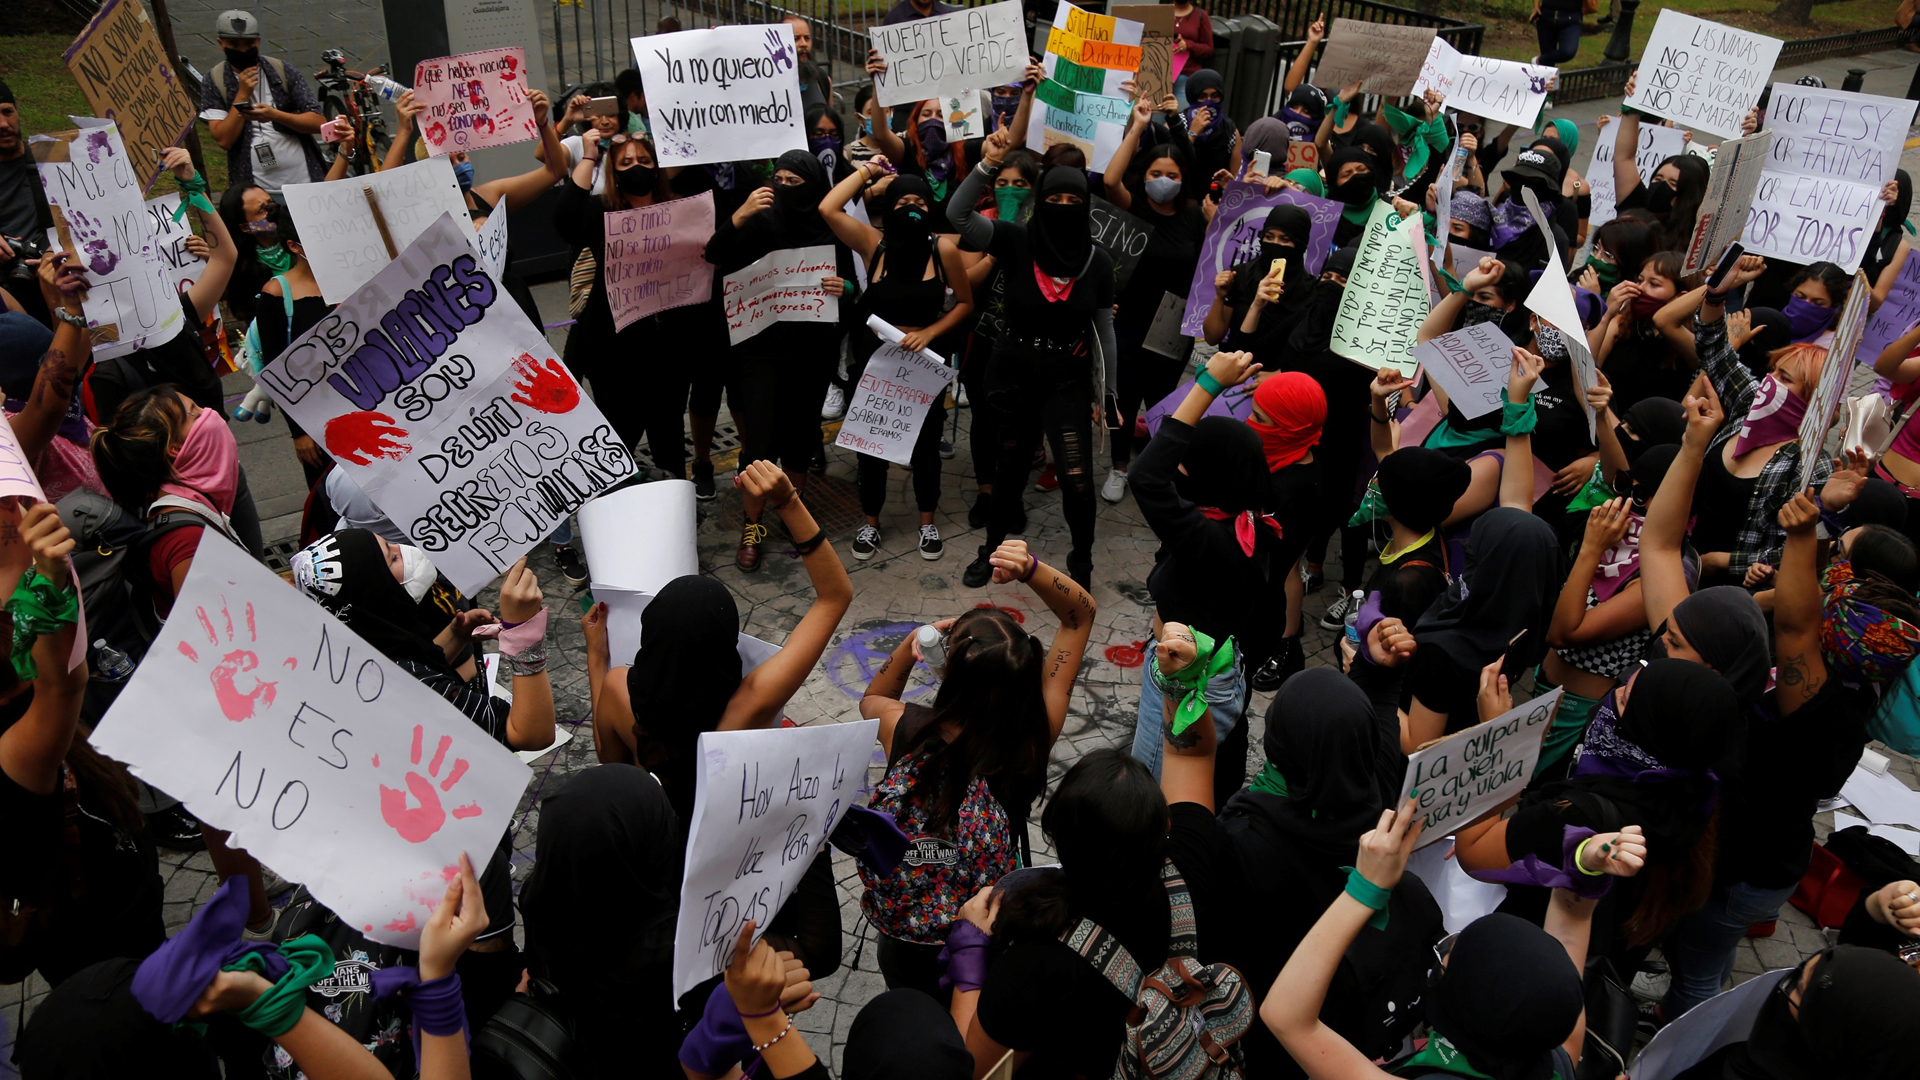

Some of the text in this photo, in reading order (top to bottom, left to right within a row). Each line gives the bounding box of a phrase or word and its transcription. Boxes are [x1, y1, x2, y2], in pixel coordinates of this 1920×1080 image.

[472, 4, 510, 14] Guadalajara
[1085, 13, 1109, 43] Hija
[79, 1, 143, 98] NO SOMOS
[871, 10, 1006, 54] MUERTE AL
[1691, 25, 1762, 66] LAS NIÑAS
[106, 39, 160, 112] HISTERICAS
[424, 57, 510, 91] que haber nacido
[654, 47, 774, 91] Ya no quiero
[874, 38, 1017, 88] VIEJO VERDE
[1659, 46, 1760, 89] NO SE TOCAN
[128, 78, 160, 127] SOMOS
[431, 104, 446, 118] no
[449, 100, 466, 115] sea
[452, 81, 485, 100] NENA
[658, 89, 795, 131] vivir con miedo!
[1457, 69, 1528, 117] TOCAN
[1641, 88, 1743, 134] NO SE MATAN
[1650, 68, 1757, 112] NO SE VIOLAN
[1774, 94, 1894, 143] POR ELSY
[56, 161, 106, 207] Mi
[608, 214, 637, 236] Las
[1789, 214, 1863, 268] TODAS
[606, 239, 624, 261] NO
[626, 240, 639, 256] se
[605, 261, 622, 286] NO
[621, 264, 635, 281] se
[749, 267, 780, 287] muros
[607, 286, 622, 312] NO
[621, 288, 633, 308] se
[1365, 287, 1401, 356] SI ALGUN
[1386, 308, 1416, 364] FULANO
[394, 354, 476, 422] SON
[896, 366, 913, 382] DE
[848, 406, 912, 432] SABIAN QUE
[865, 394, 913, 417] PERO NO
[840, 431, 884, 455] SEMILLAS
[870, 426, 902, 441] ERAMOS
[410, 421, 570, 552] SECRETOS
[312, 623, 385, 703] NO
[288, 701, 354, 770] ES
[1414, 700, 1555, 788] La culpa es
[215, 751, 310, 830] NO
[1441, 749, 1504, 797] quien
[1477, 759, 1524, 797] viola
[904, 849, 918, 857] OFF
[920, 849, 937, 859] THE
[916, 841, 939, 850] VANS
[333, 965, 360, 978] VANS
[337, 974, 356, 986] THE
